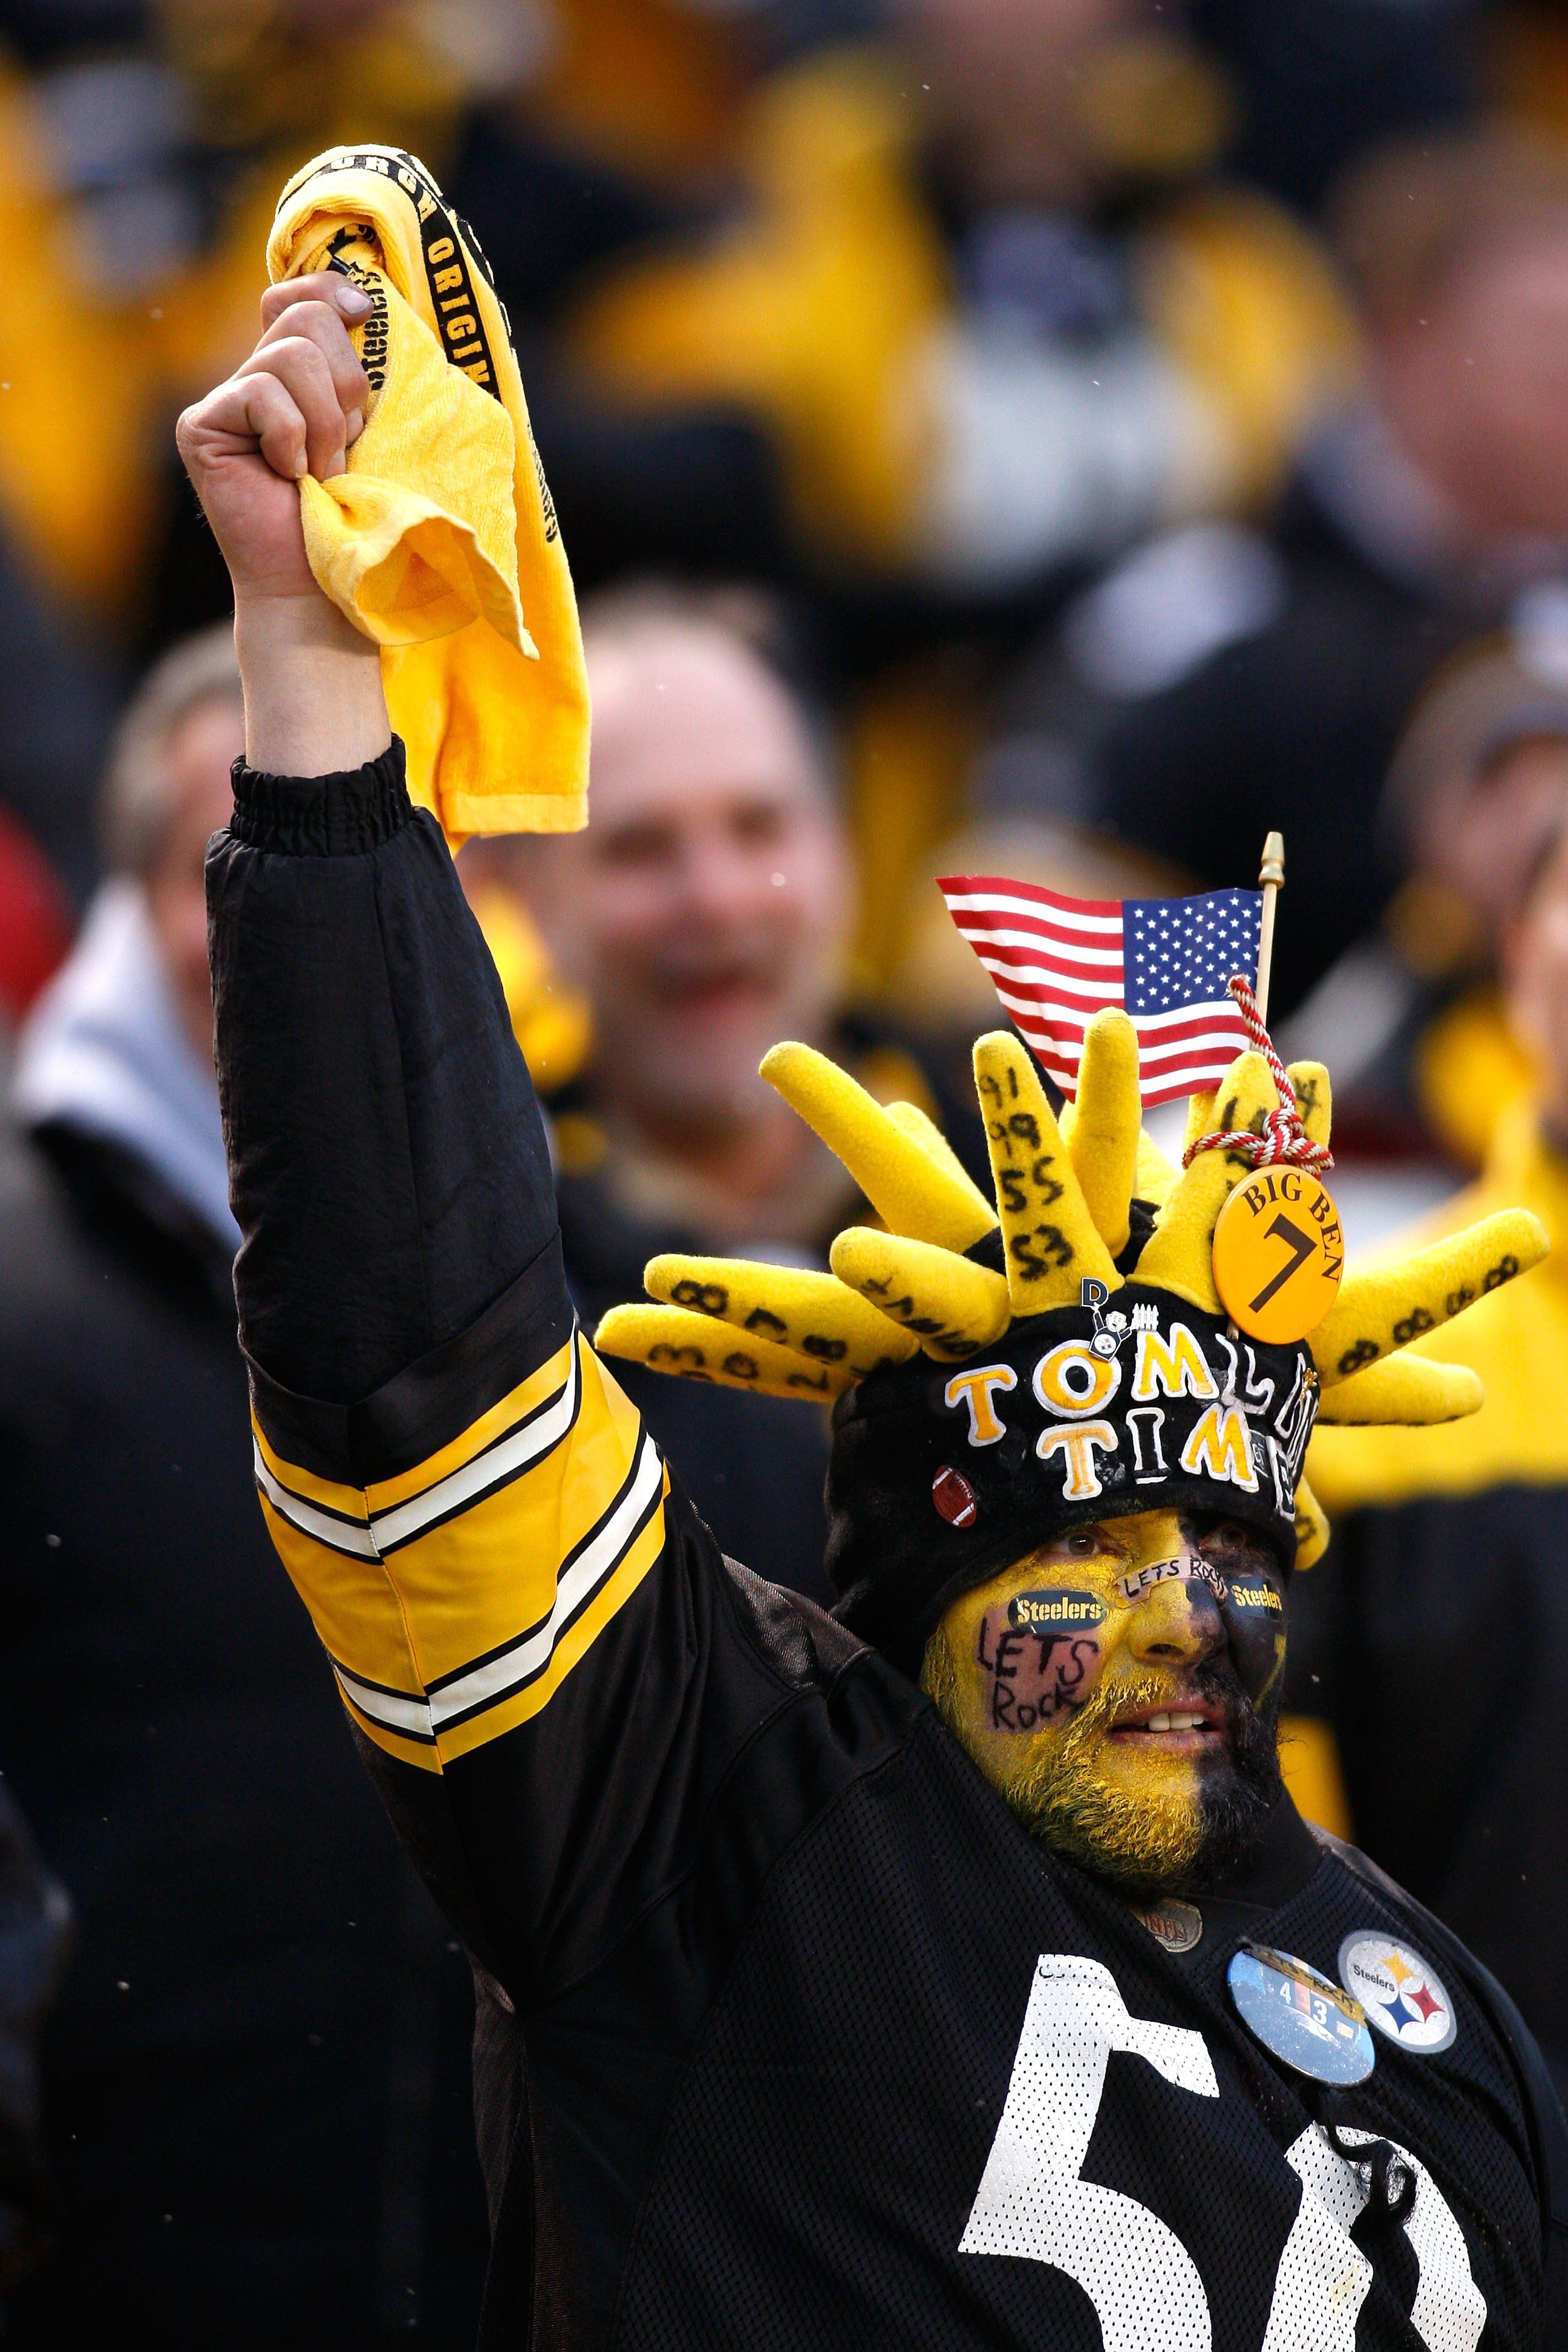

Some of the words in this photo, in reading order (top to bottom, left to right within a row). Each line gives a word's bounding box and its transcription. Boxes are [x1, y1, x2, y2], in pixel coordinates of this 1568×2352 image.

[1241, 1172, 1302, 1217] BIG
[1308, 1191, 1343, 1283] BEN
[1249, 1212, 1318, 1313] 7
[1081, 1276, 1109, 1307] D
[1036, 1402, 1296, 1522] TIME
[1123, 1560, 1180, 1598] LETS
[1231, 1584, 1283, 1612] Steelers
[1016, 1596, 1102, 1622] Steelers
[976, 1616, 1100, 1687] LETS
[993, 1679, 1080, 1730] ROCK
[1353, 1964, 1396, 1992] Steelers
